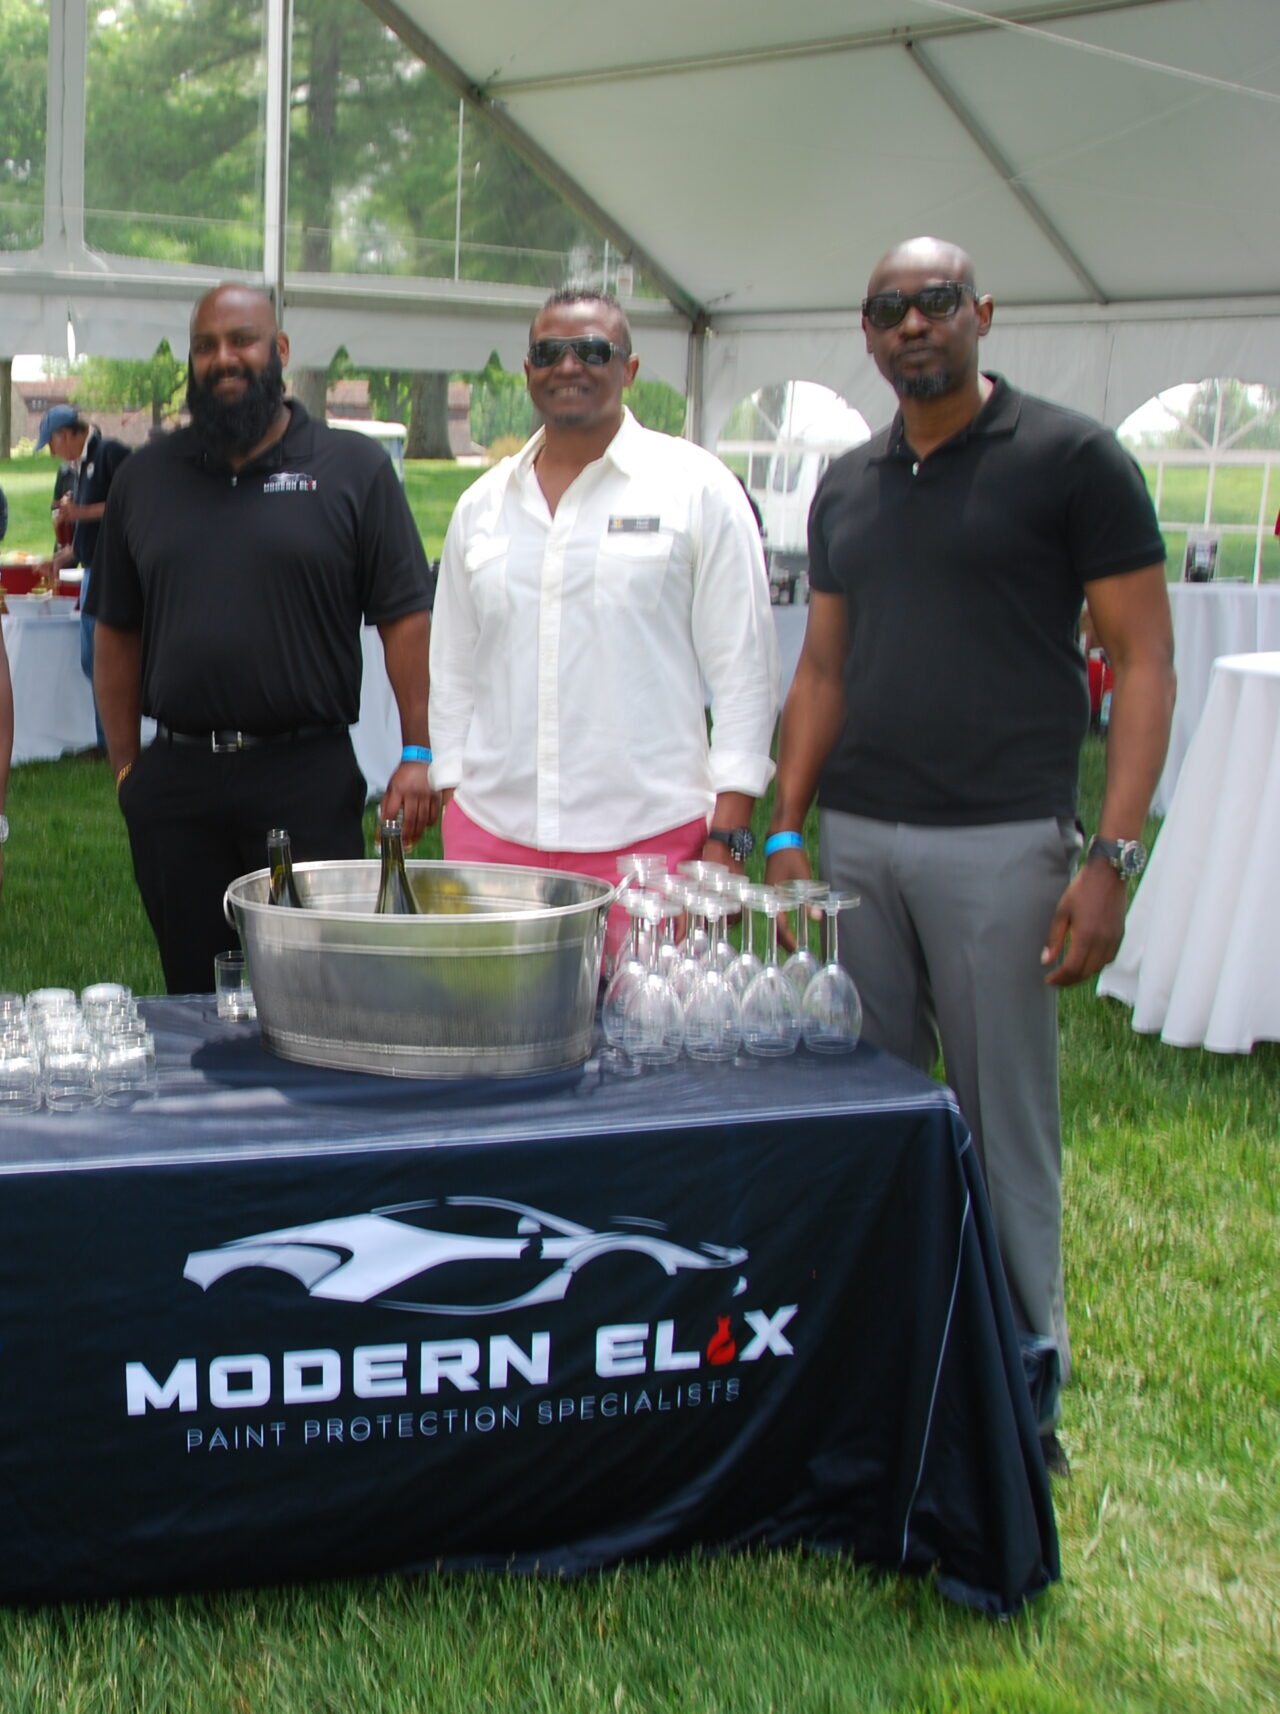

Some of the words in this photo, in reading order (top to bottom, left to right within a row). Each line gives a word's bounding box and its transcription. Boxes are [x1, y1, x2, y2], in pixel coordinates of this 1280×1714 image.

[125, 1331, 551, 1416] MODERN
[186, 1421, 286, 1453] PAINT
[304, 1403, 521, 1446] PROTECTION
[536, 1377, 741, 1424] SPECIALISTS
